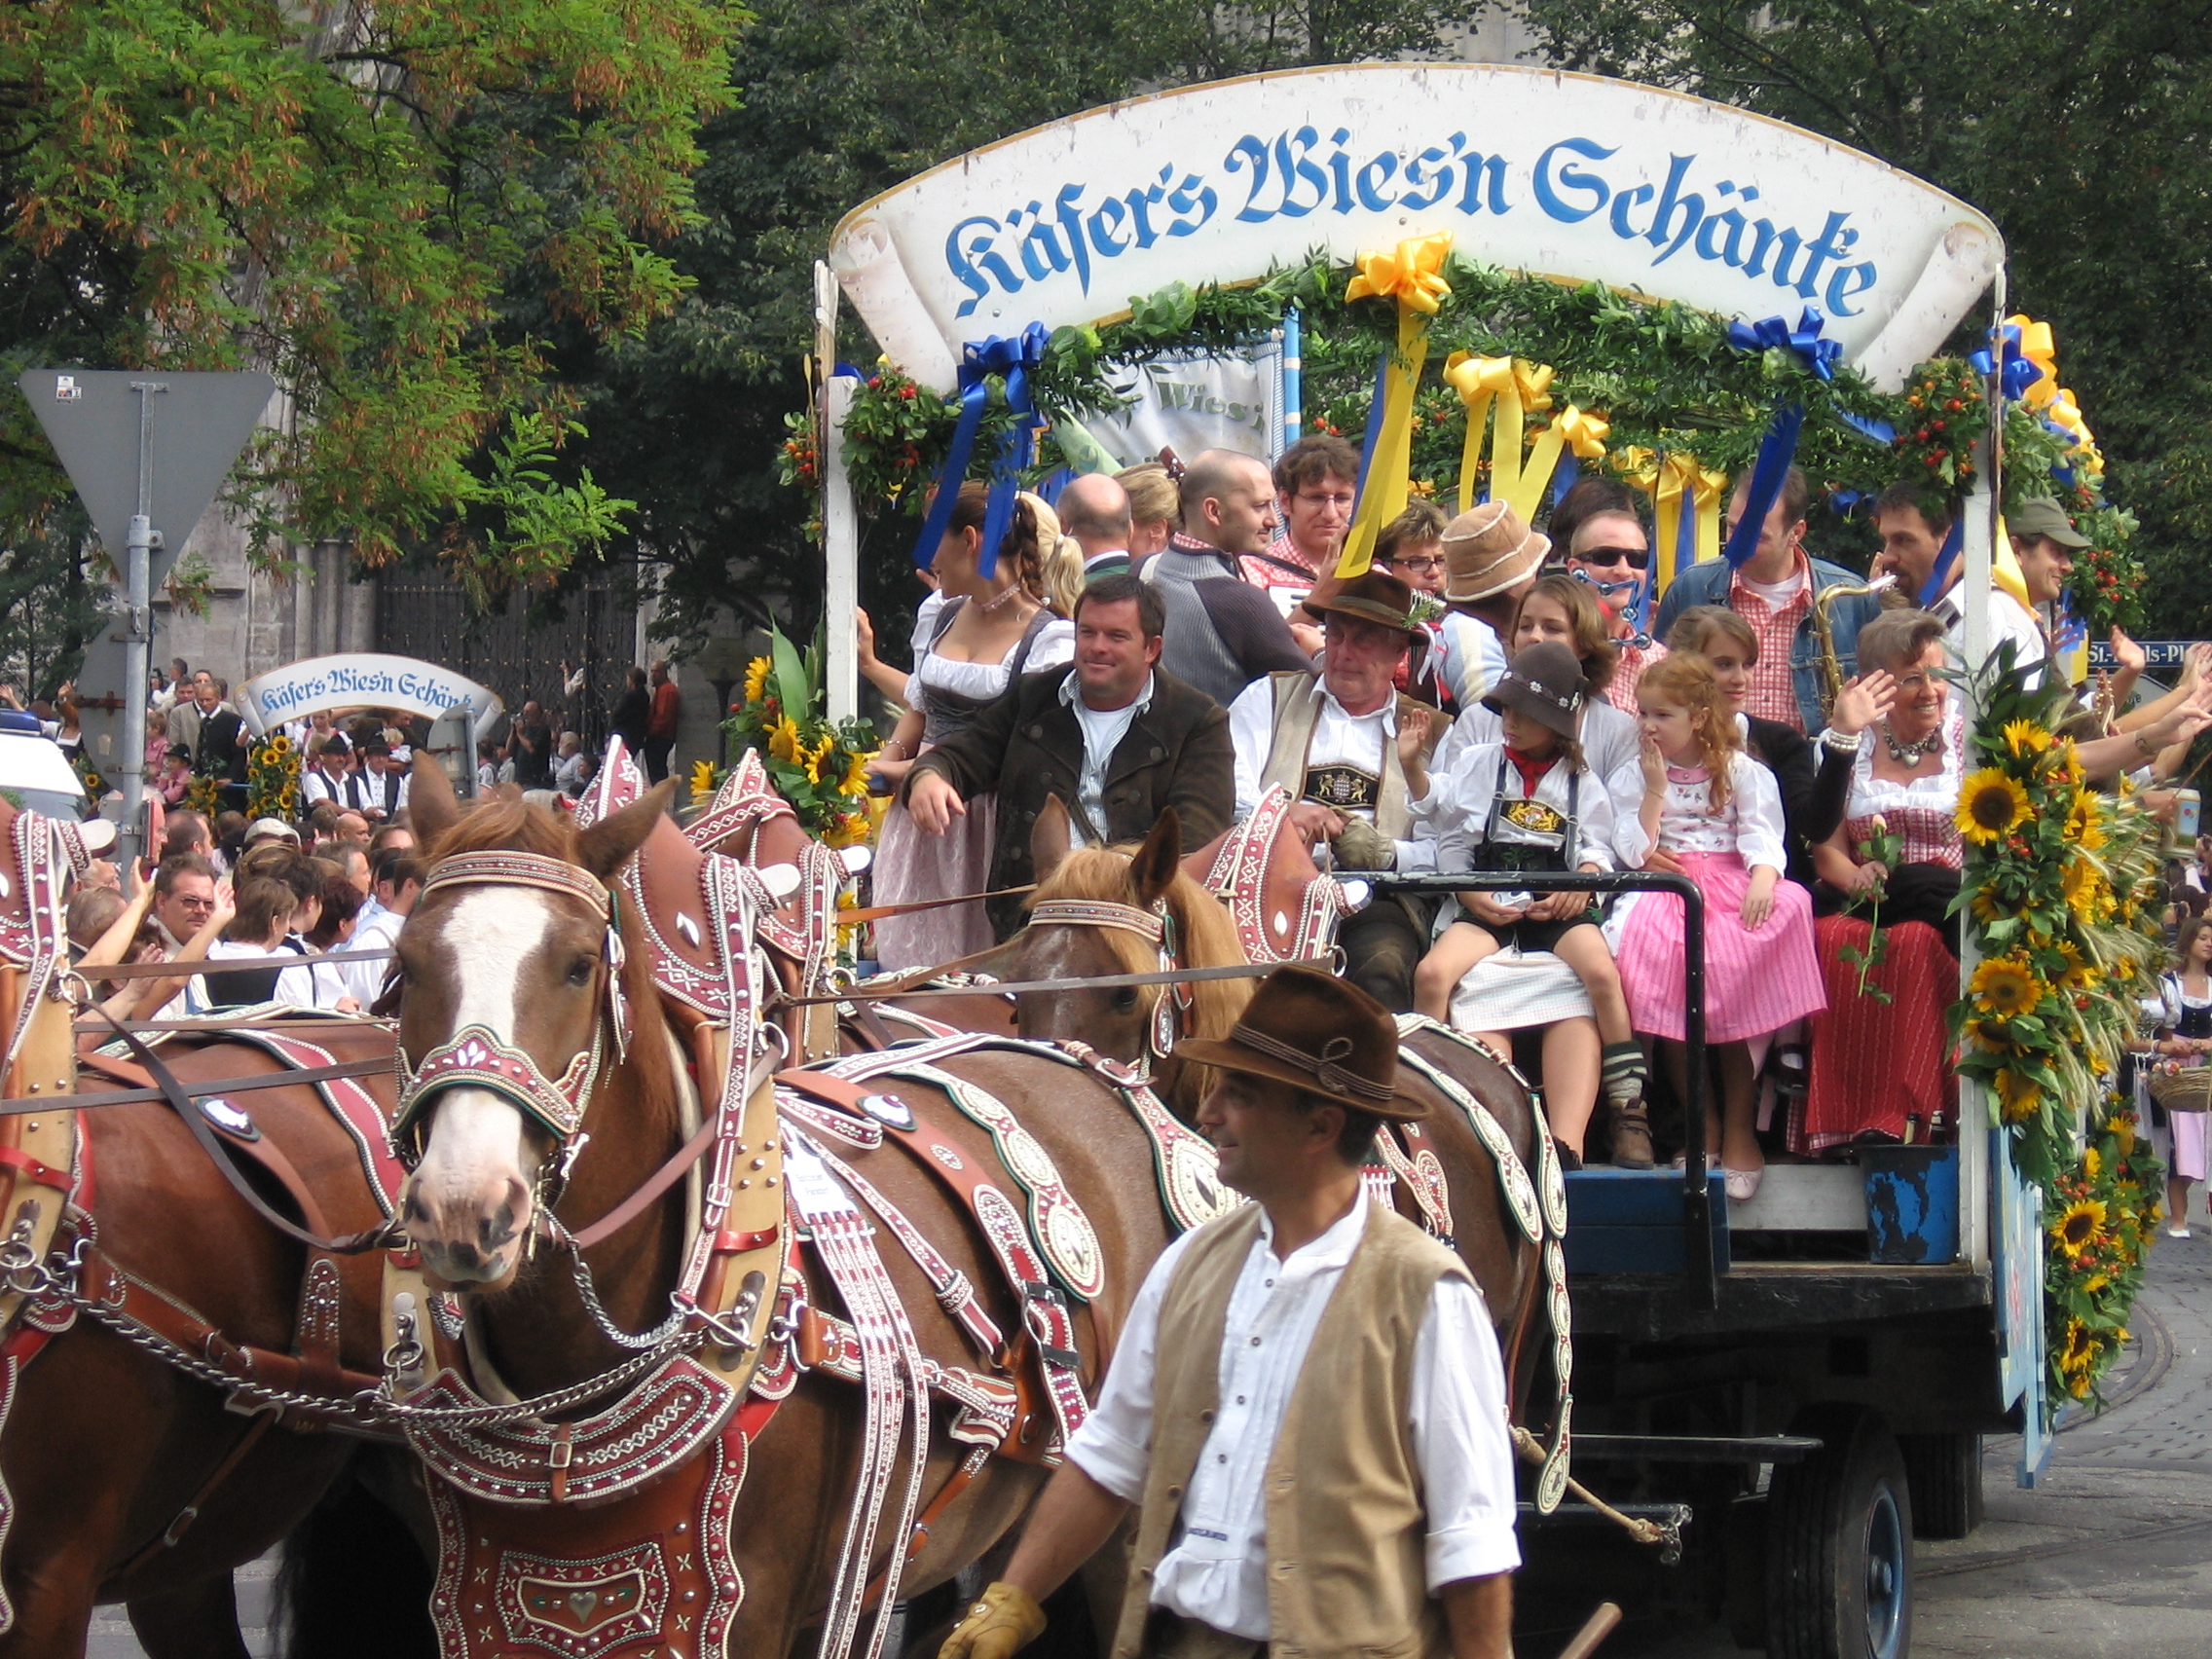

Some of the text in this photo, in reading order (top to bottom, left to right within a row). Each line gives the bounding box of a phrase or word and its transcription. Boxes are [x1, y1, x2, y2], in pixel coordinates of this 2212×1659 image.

[945, 126, 1877, 318] Käfer's Wies'n Schänke
[261, 677, 326, 716] Käfer's
[327, 668, 394, 693] Wies'n
